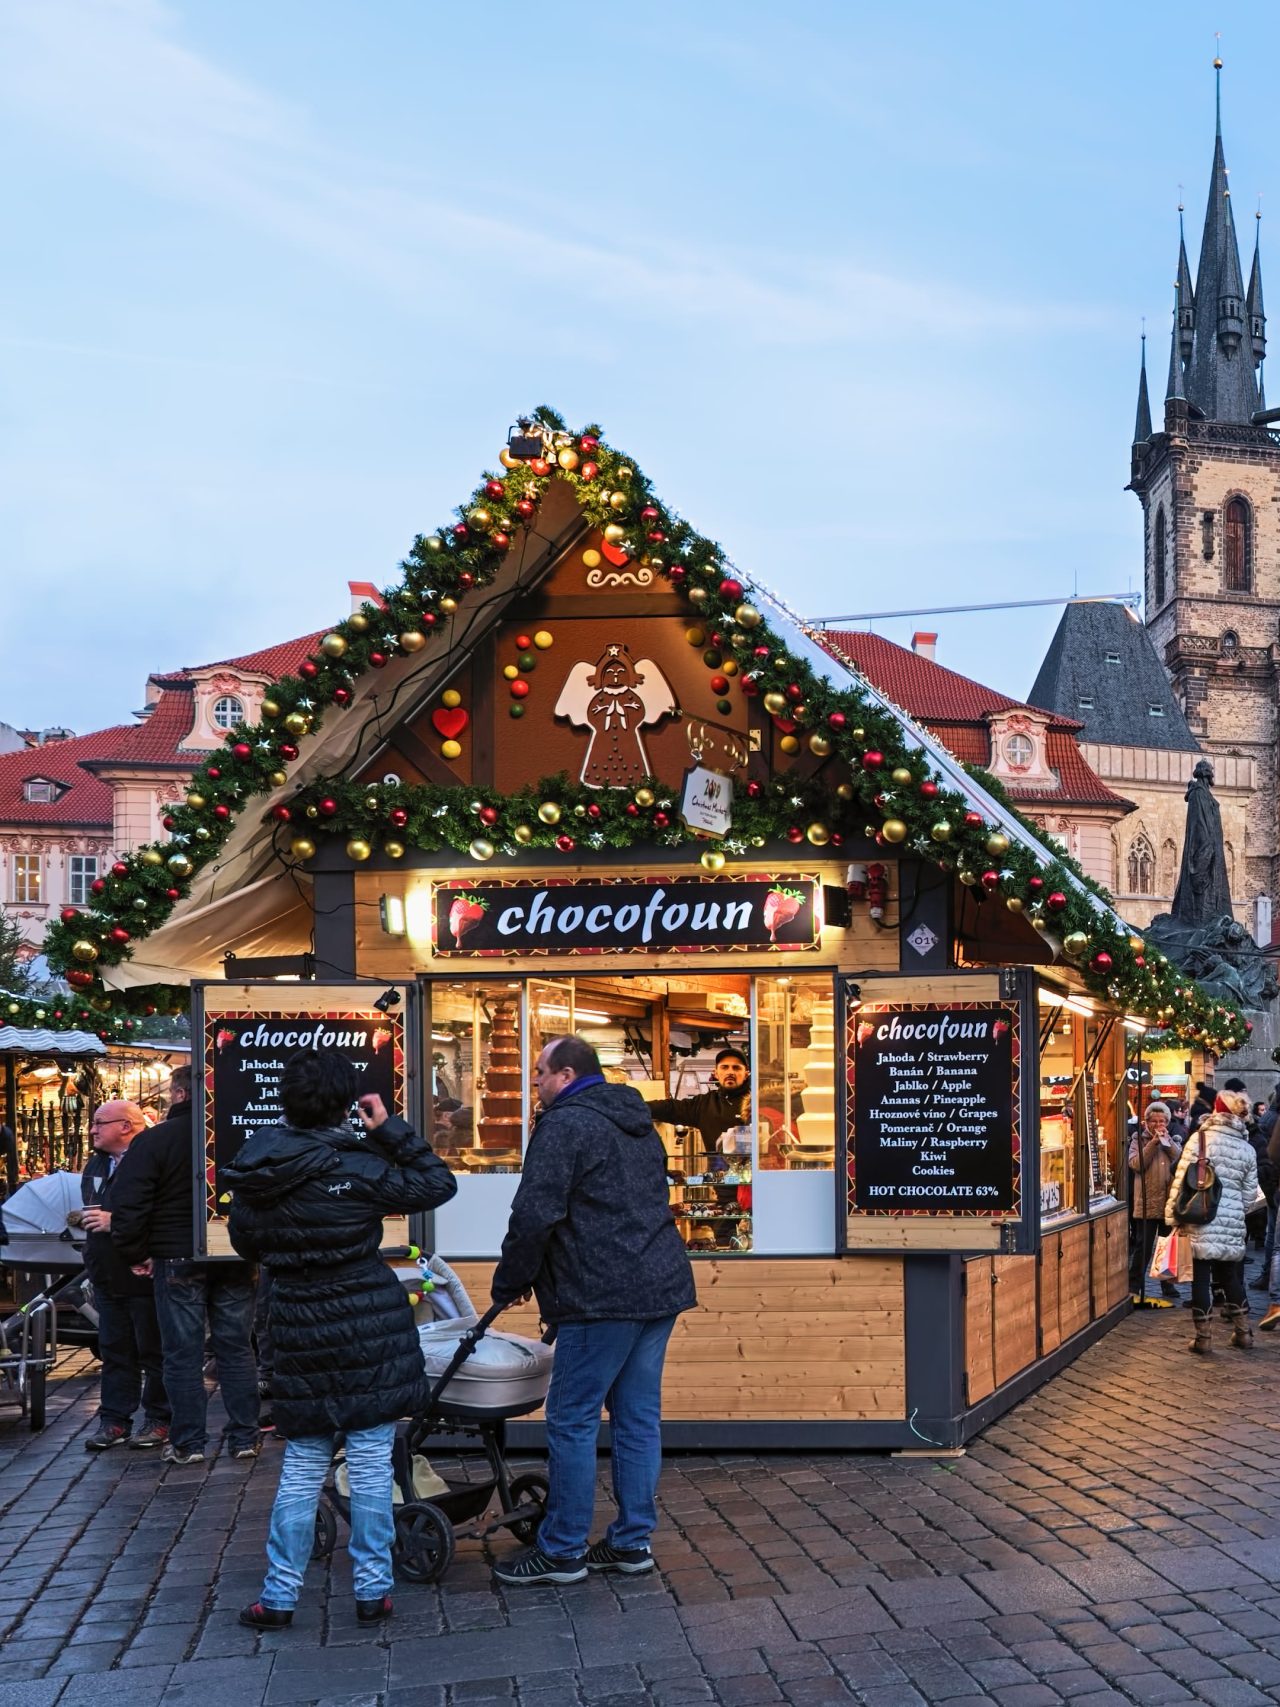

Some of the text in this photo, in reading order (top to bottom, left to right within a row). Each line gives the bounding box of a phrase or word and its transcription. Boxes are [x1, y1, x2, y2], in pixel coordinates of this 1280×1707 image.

[497, 888, 754, 943] chocofoun
[914, 936, 930, 945] 01
[876, 1015, 988, 1045] chocofoun
[240, 1024, 368, 1051] chocofoun
[876, 1053, 915, 1065] Jahoda
[927, 1052, 989, 1064] Strawberry
[240, 1060, 284, 1072] Jahoda
[889, 1067, 924, 1077] Banán
[936, 1066, 978, 1076] Banana
[255, 1073, 281, 1083] Ban
[893, 1081, 929, 1093] Jablko
[941, 1080, 972, 1093] Apple
[881, 1095, 921, 1105] Ananas
[933, 1094, 987, 1107] Pineapple
[232, 1115, 278, 1125] Hrozno
[869, 1108, 921, 1119] Hroznové
[923, 1111, 946, 1119] víno
[959, 1108, 998, 1120] Grapes
[880, 1122, 934, 1133] Pomeranč
[946, 1123, 987, 1135] Orange
[880, 1138, 918, 1149] Maliny
[930, 1137, 988, 1149] Raspberry
[920, 1151, 947, 1161] Kiwi
[912, 1165, 955, 1176] Cookies
[869, 1186, 999, 1196] HOT CHOCOLATE 63%
